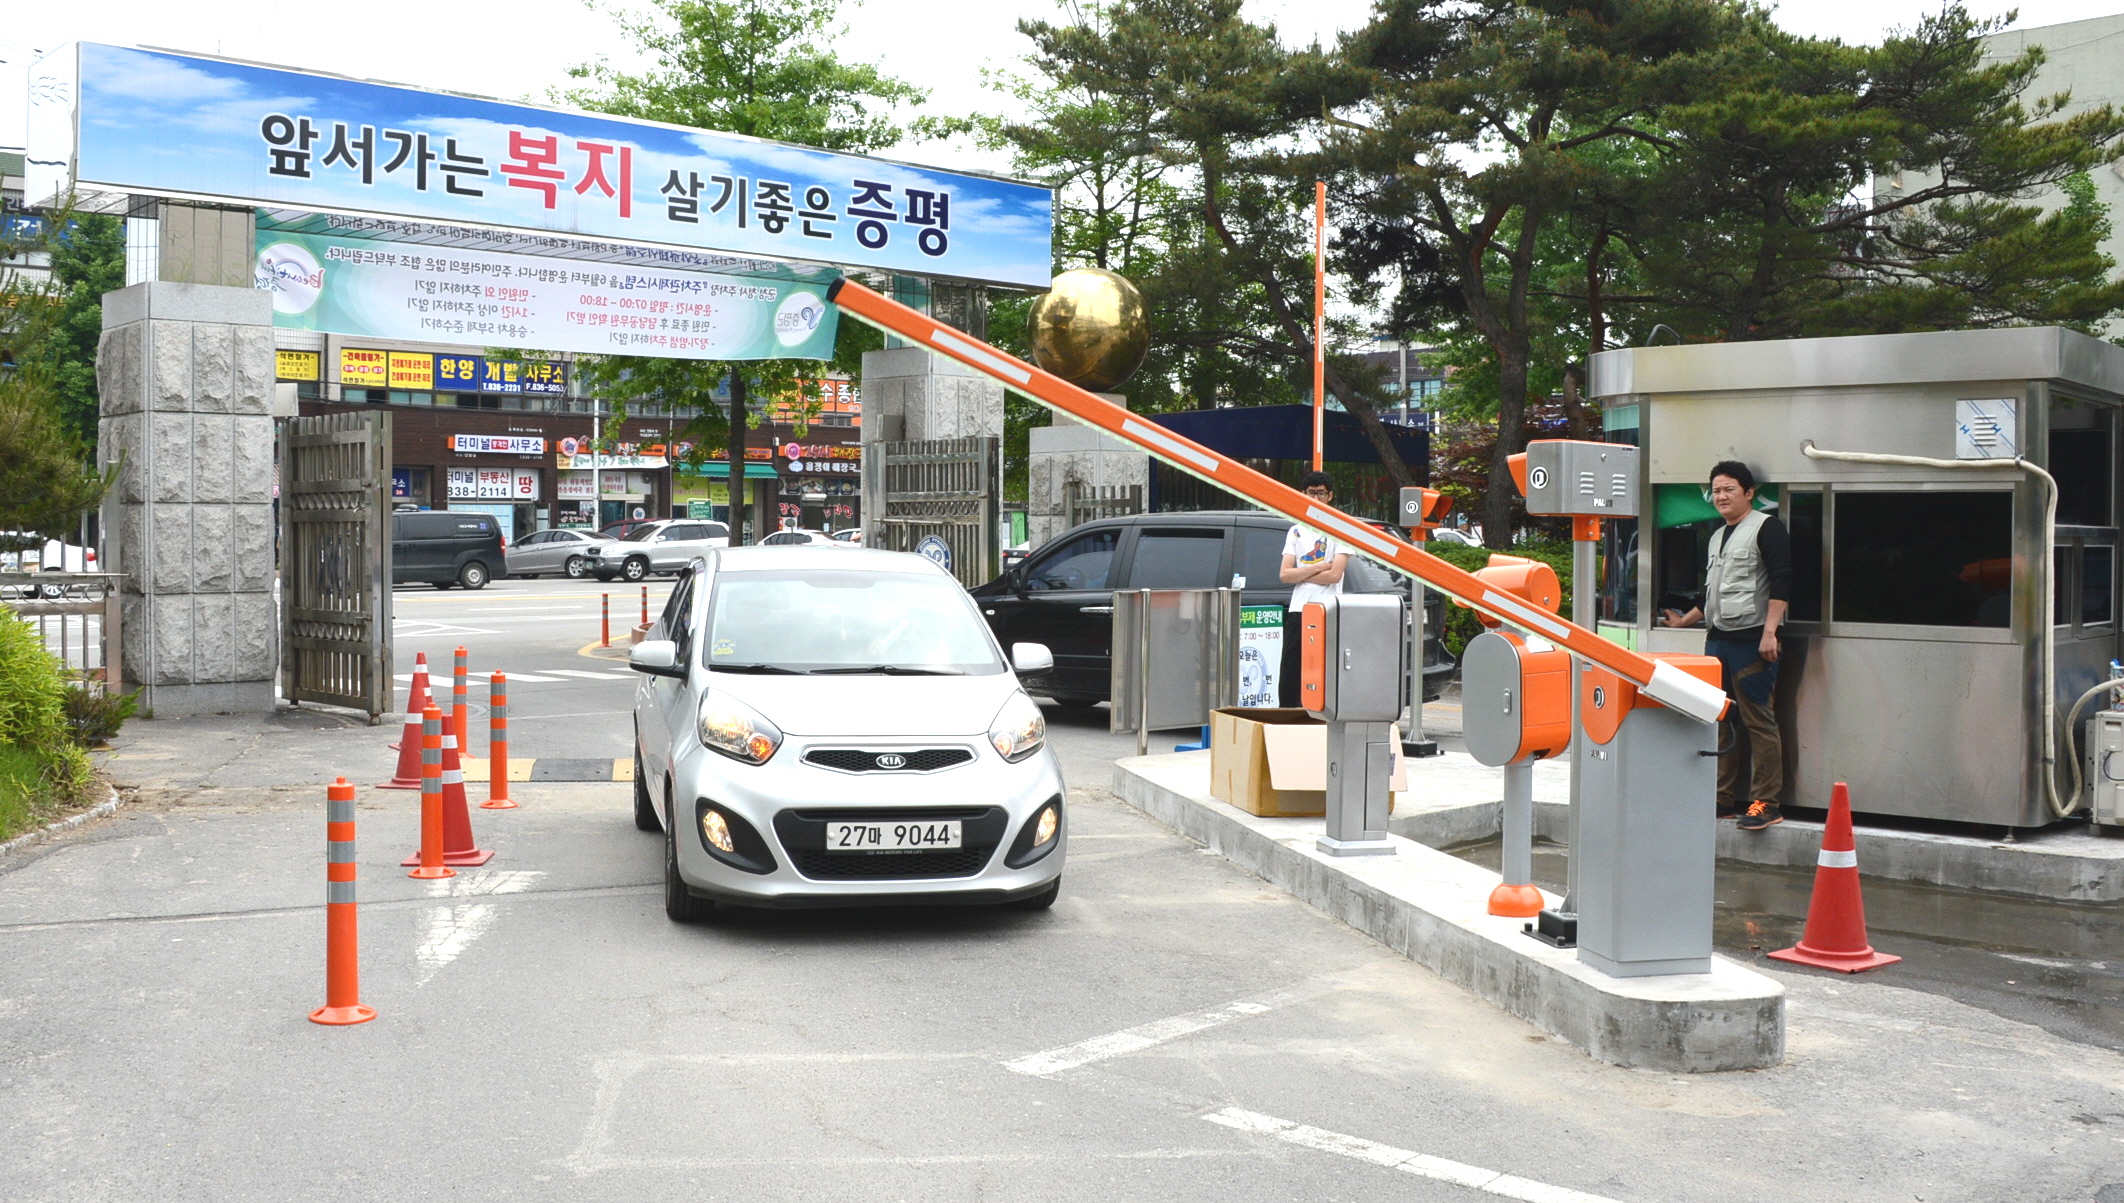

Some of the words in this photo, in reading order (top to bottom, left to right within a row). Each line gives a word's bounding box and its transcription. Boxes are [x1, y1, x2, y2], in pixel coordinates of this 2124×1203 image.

[261, 114, 489, 197] 앞서가는
[500, 130, 632, 219] 복지
[661, 169, 837, 239] 살기좋은
[847, 179, 950, 257] 증평
[440, 359, 475, 380] 한양
[485, 362, 518, 382] 개발
[526, 363, 564, 383] 사무소
[458, 437, 490, 451] 터미널
[510, 439, 541, 452] 사무소
[480, 471, 510, 484] 부동산
[480, 486, 507, 497] 2114
[518, 476, 534, 494] 땅
[1244, 632, 1257, 641] 7:00
[1265, 631, 1280, 640] 18:00
[1265, 675, 1272, 685] 번
[1242, 693, 1274, 707] 날입니다.
[881, 756, 901, 766] KIA
[839, 825, 882, 847] 27마
[894, 824, 950, 846] 9044
